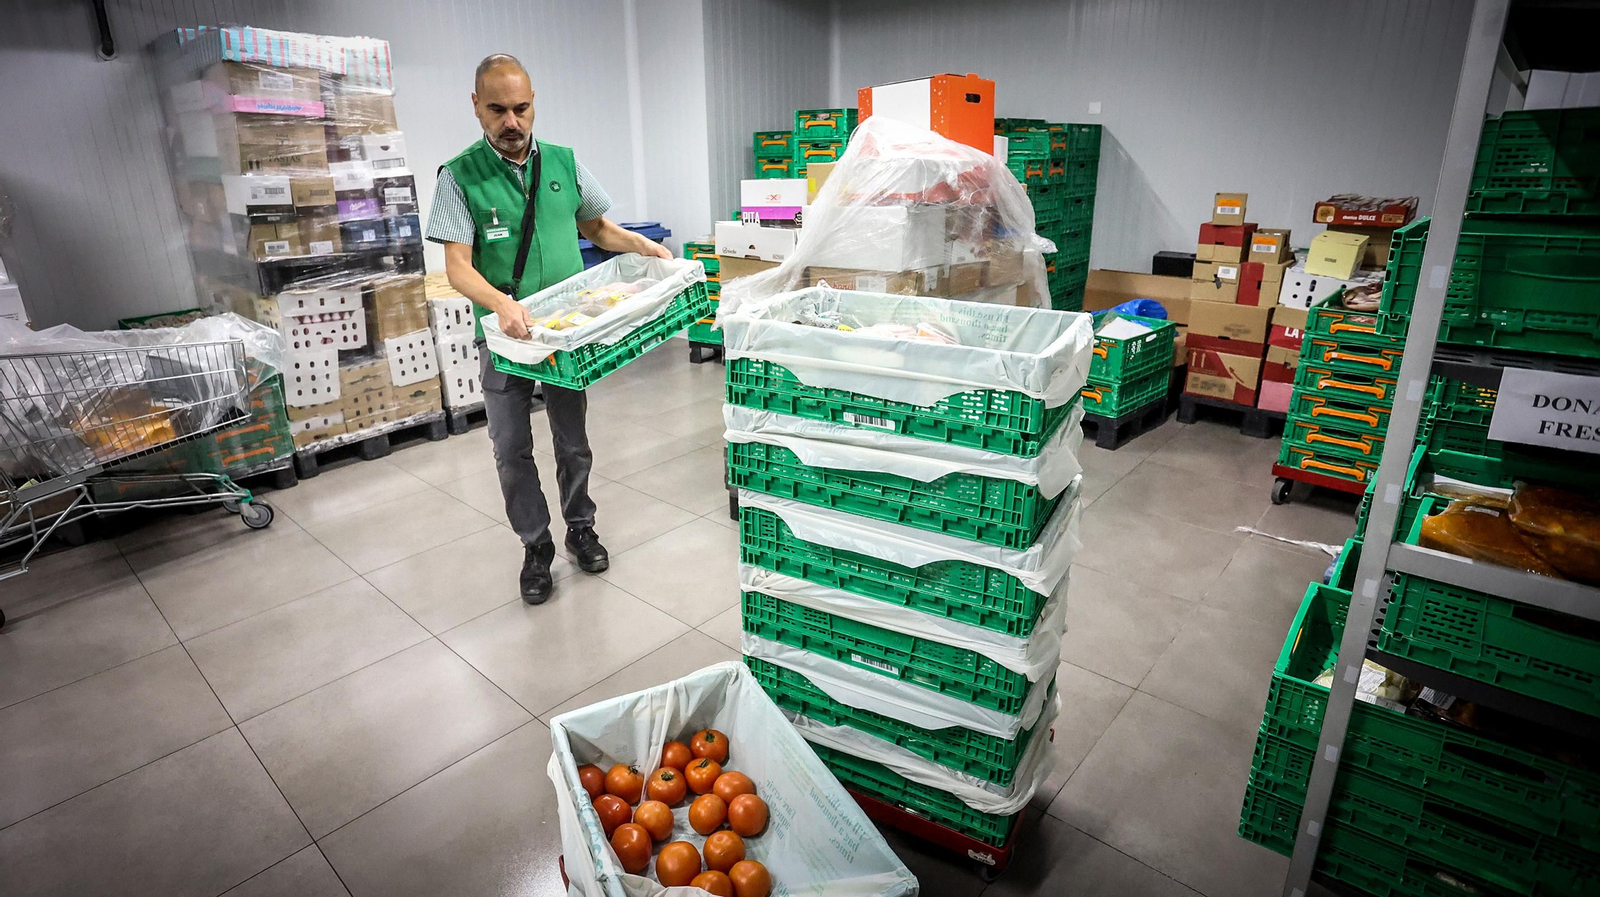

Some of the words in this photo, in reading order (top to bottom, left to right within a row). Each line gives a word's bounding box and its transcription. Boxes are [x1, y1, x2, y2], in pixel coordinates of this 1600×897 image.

[743, 211, 760, 224] PITA
[1358, 214, 1377, 222] DULCE
[1284, 326, 1300, 339] LA
